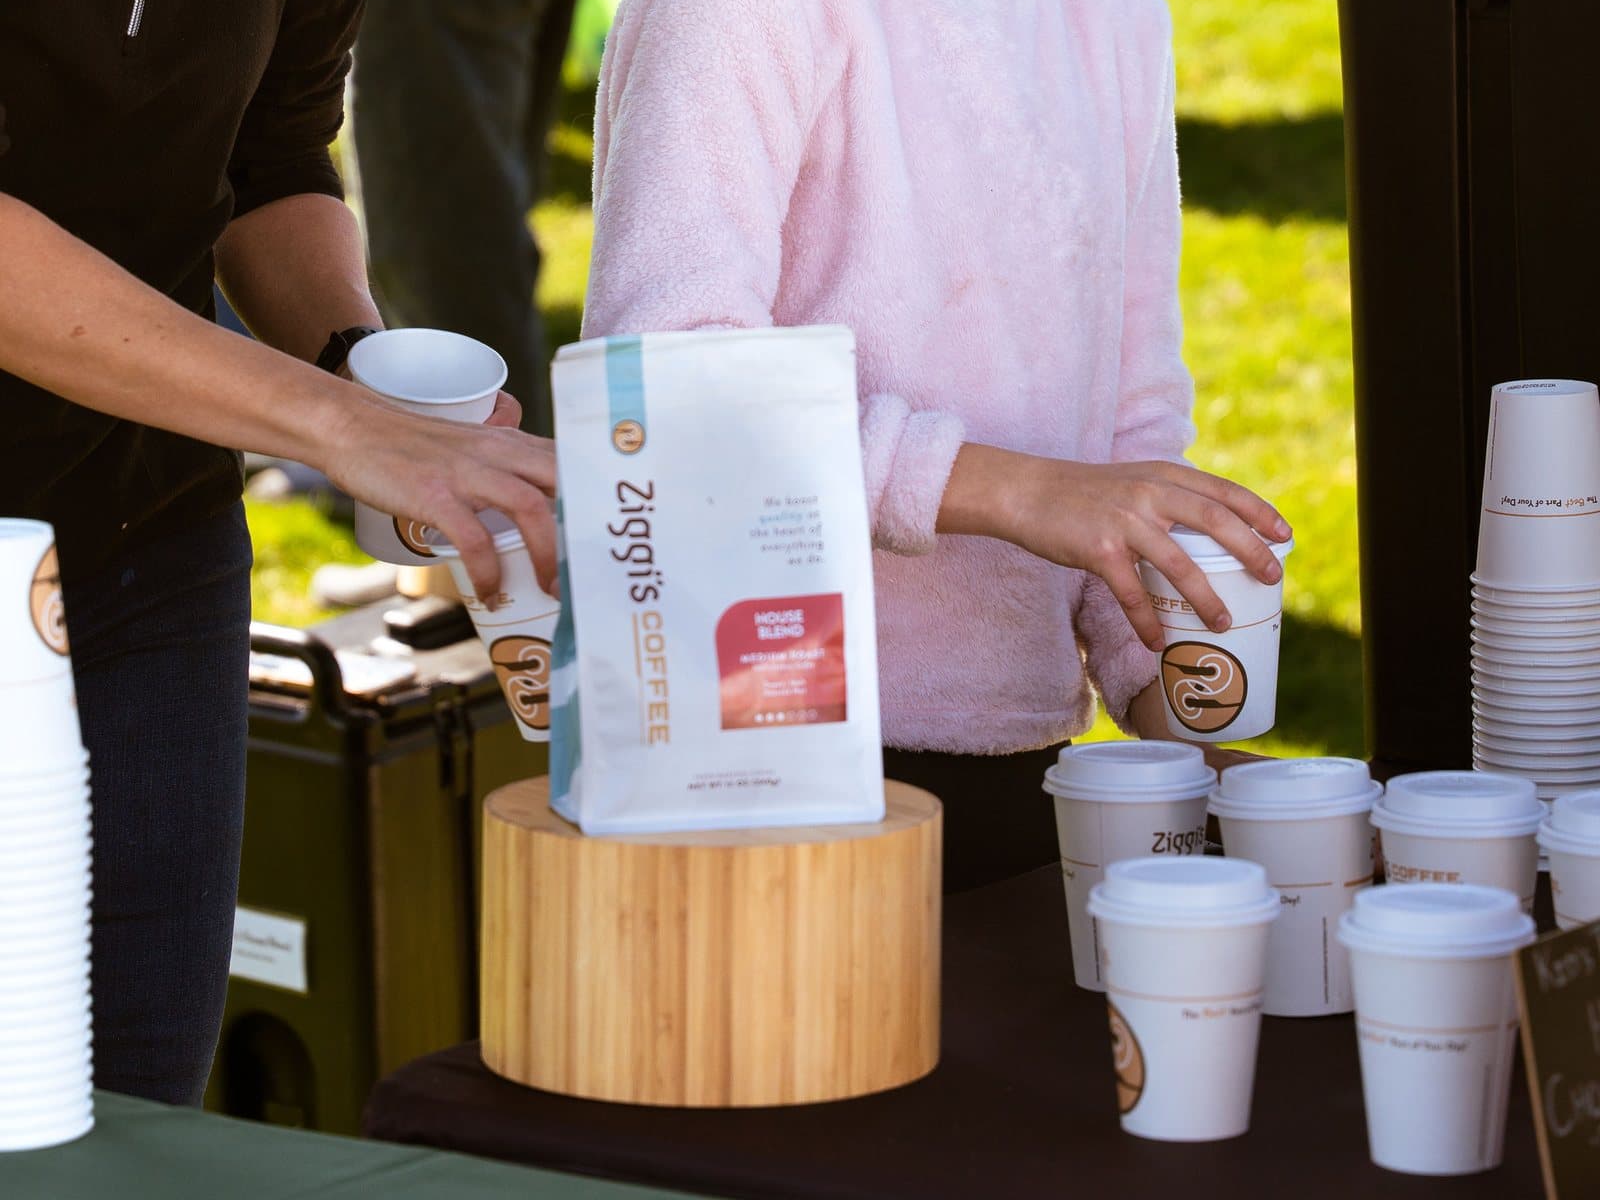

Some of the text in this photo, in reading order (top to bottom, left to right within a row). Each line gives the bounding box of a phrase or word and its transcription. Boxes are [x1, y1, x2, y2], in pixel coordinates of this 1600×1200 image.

[1517, 499, 1534, 508] Your
[1535, 498, 1544, 507] of
[1546, 499, 1562, 507] Part
[1586, 496, 1598, 504] The
[608, 479, 671, 745] Ziggi's COFFEE
[754, 609, 804, 625] HOUSE
[757, 623, 804, 640] BLEND
